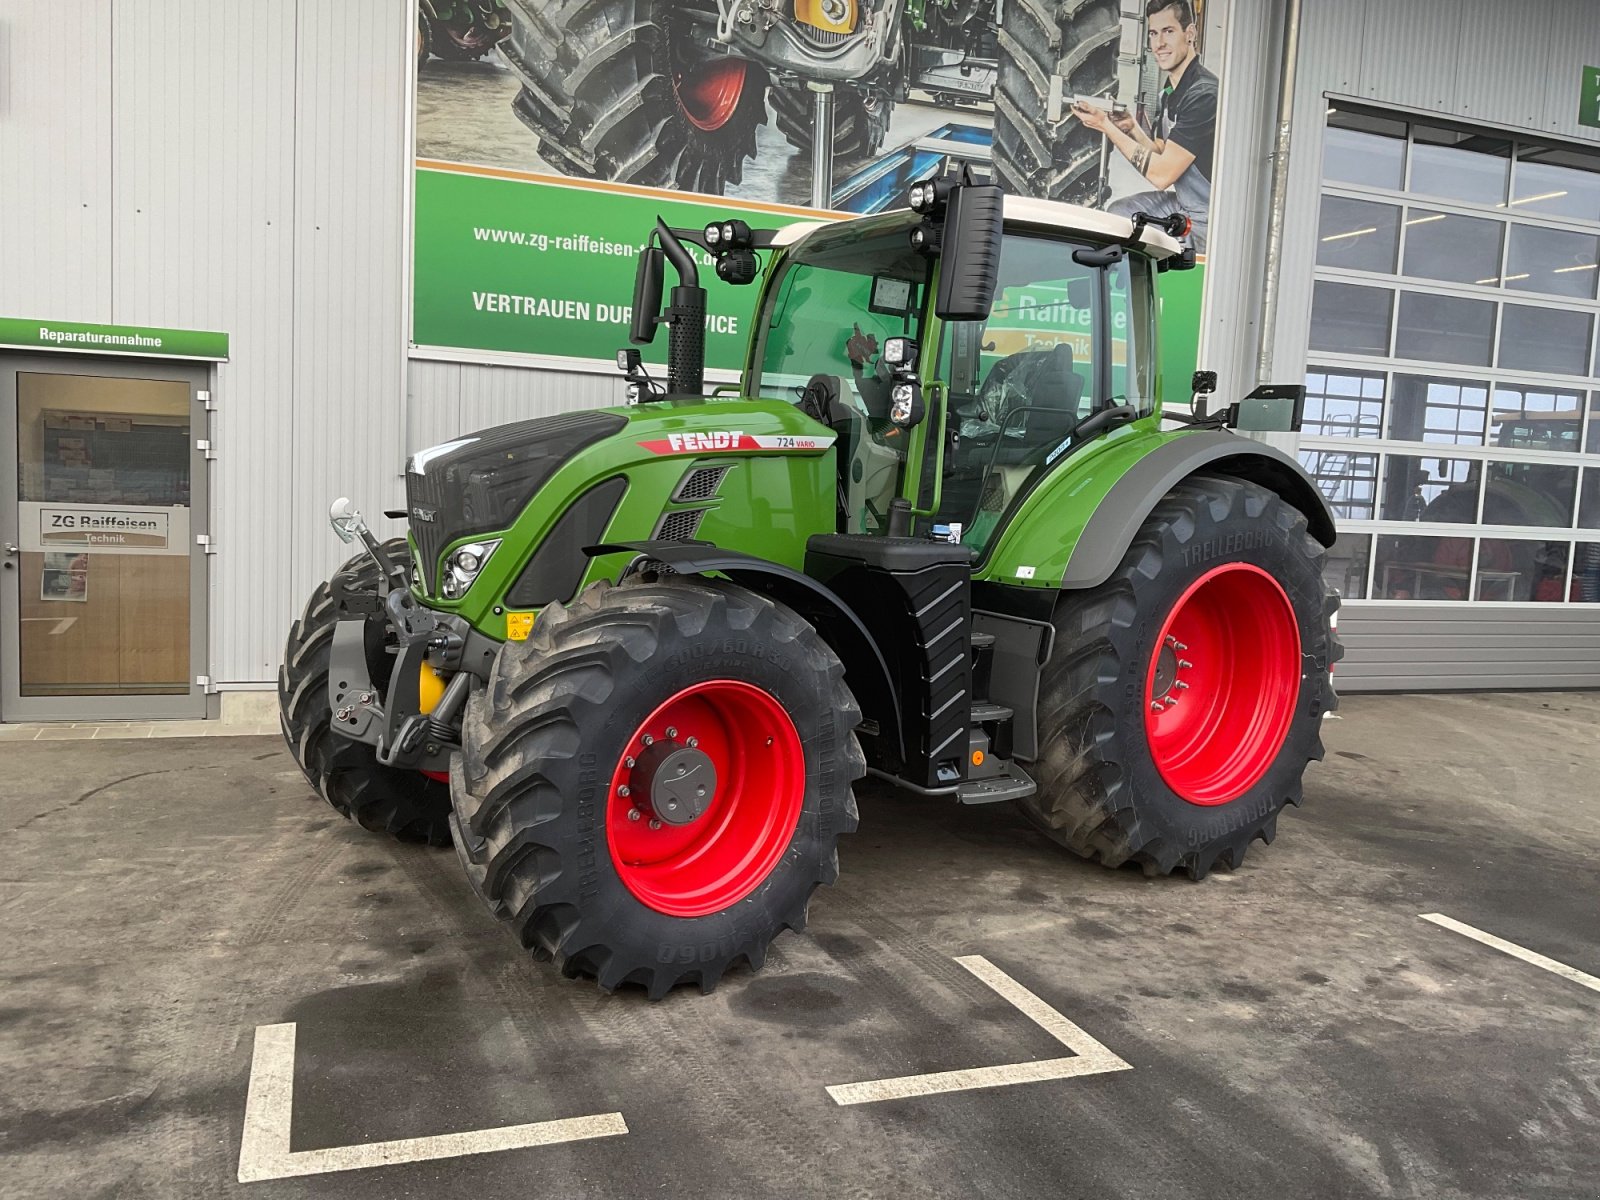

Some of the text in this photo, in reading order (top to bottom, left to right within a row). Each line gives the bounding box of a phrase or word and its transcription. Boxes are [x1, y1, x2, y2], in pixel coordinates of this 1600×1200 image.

[473, 227, 719, 266] www.zg-raiffeisen-k.d
[472, 291, 590, 320] VERTRAUEN
[596, 303, 632, 325] DUR
[1018, 295, 1127, 329] Raiffee
[39, 327, 162, 347] Reparaturannahme
[667, 430, 816, 451] FENDT 724 VARIO
[51, 514, 157, 530] ZG Raiffeisen
[84, 533, 126, 544] Technik
[1180, 529, 1274, 567] TRELLEBORG
